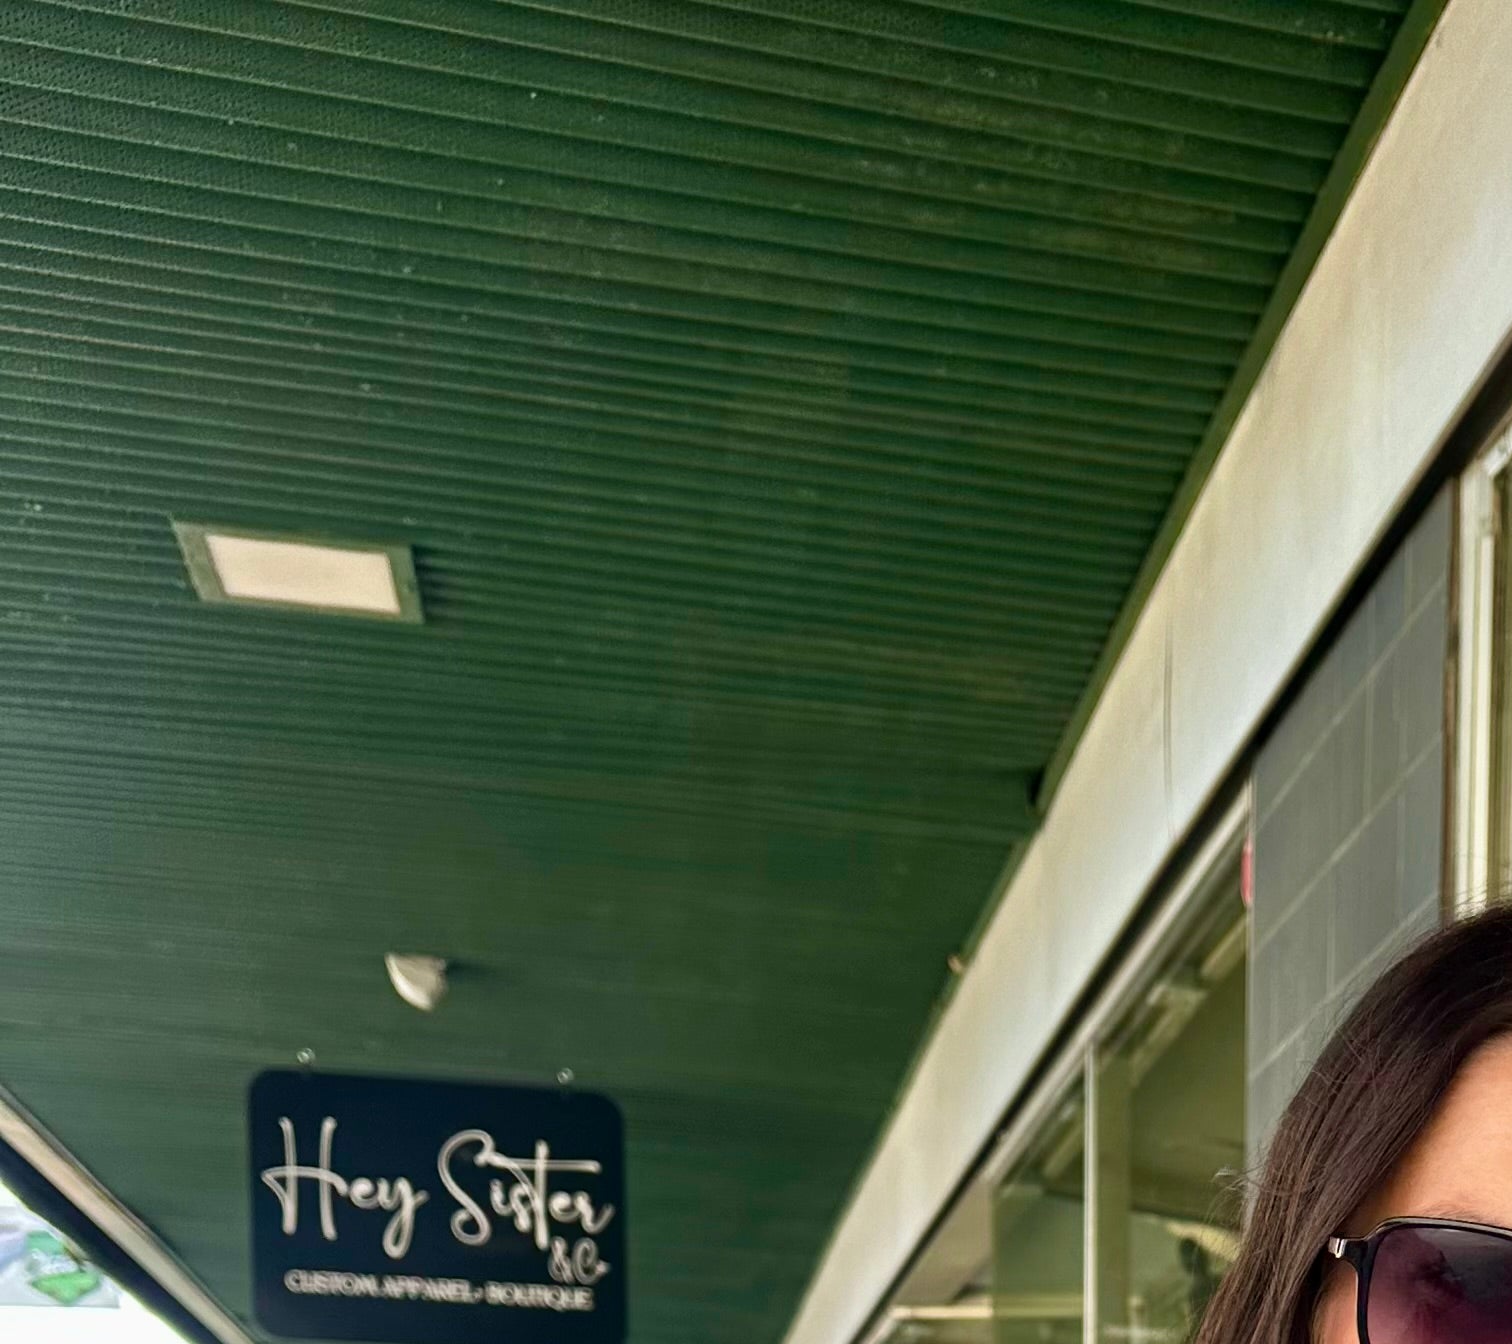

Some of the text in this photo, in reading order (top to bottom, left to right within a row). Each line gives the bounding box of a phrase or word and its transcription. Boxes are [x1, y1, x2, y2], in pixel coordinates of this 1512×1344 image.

[261, 1116, 616, 1259] Hey Sister
[284, 1269, 379, 1297] CUSTOM
[485, 1280, 596, 1312] BOUTIQUE
